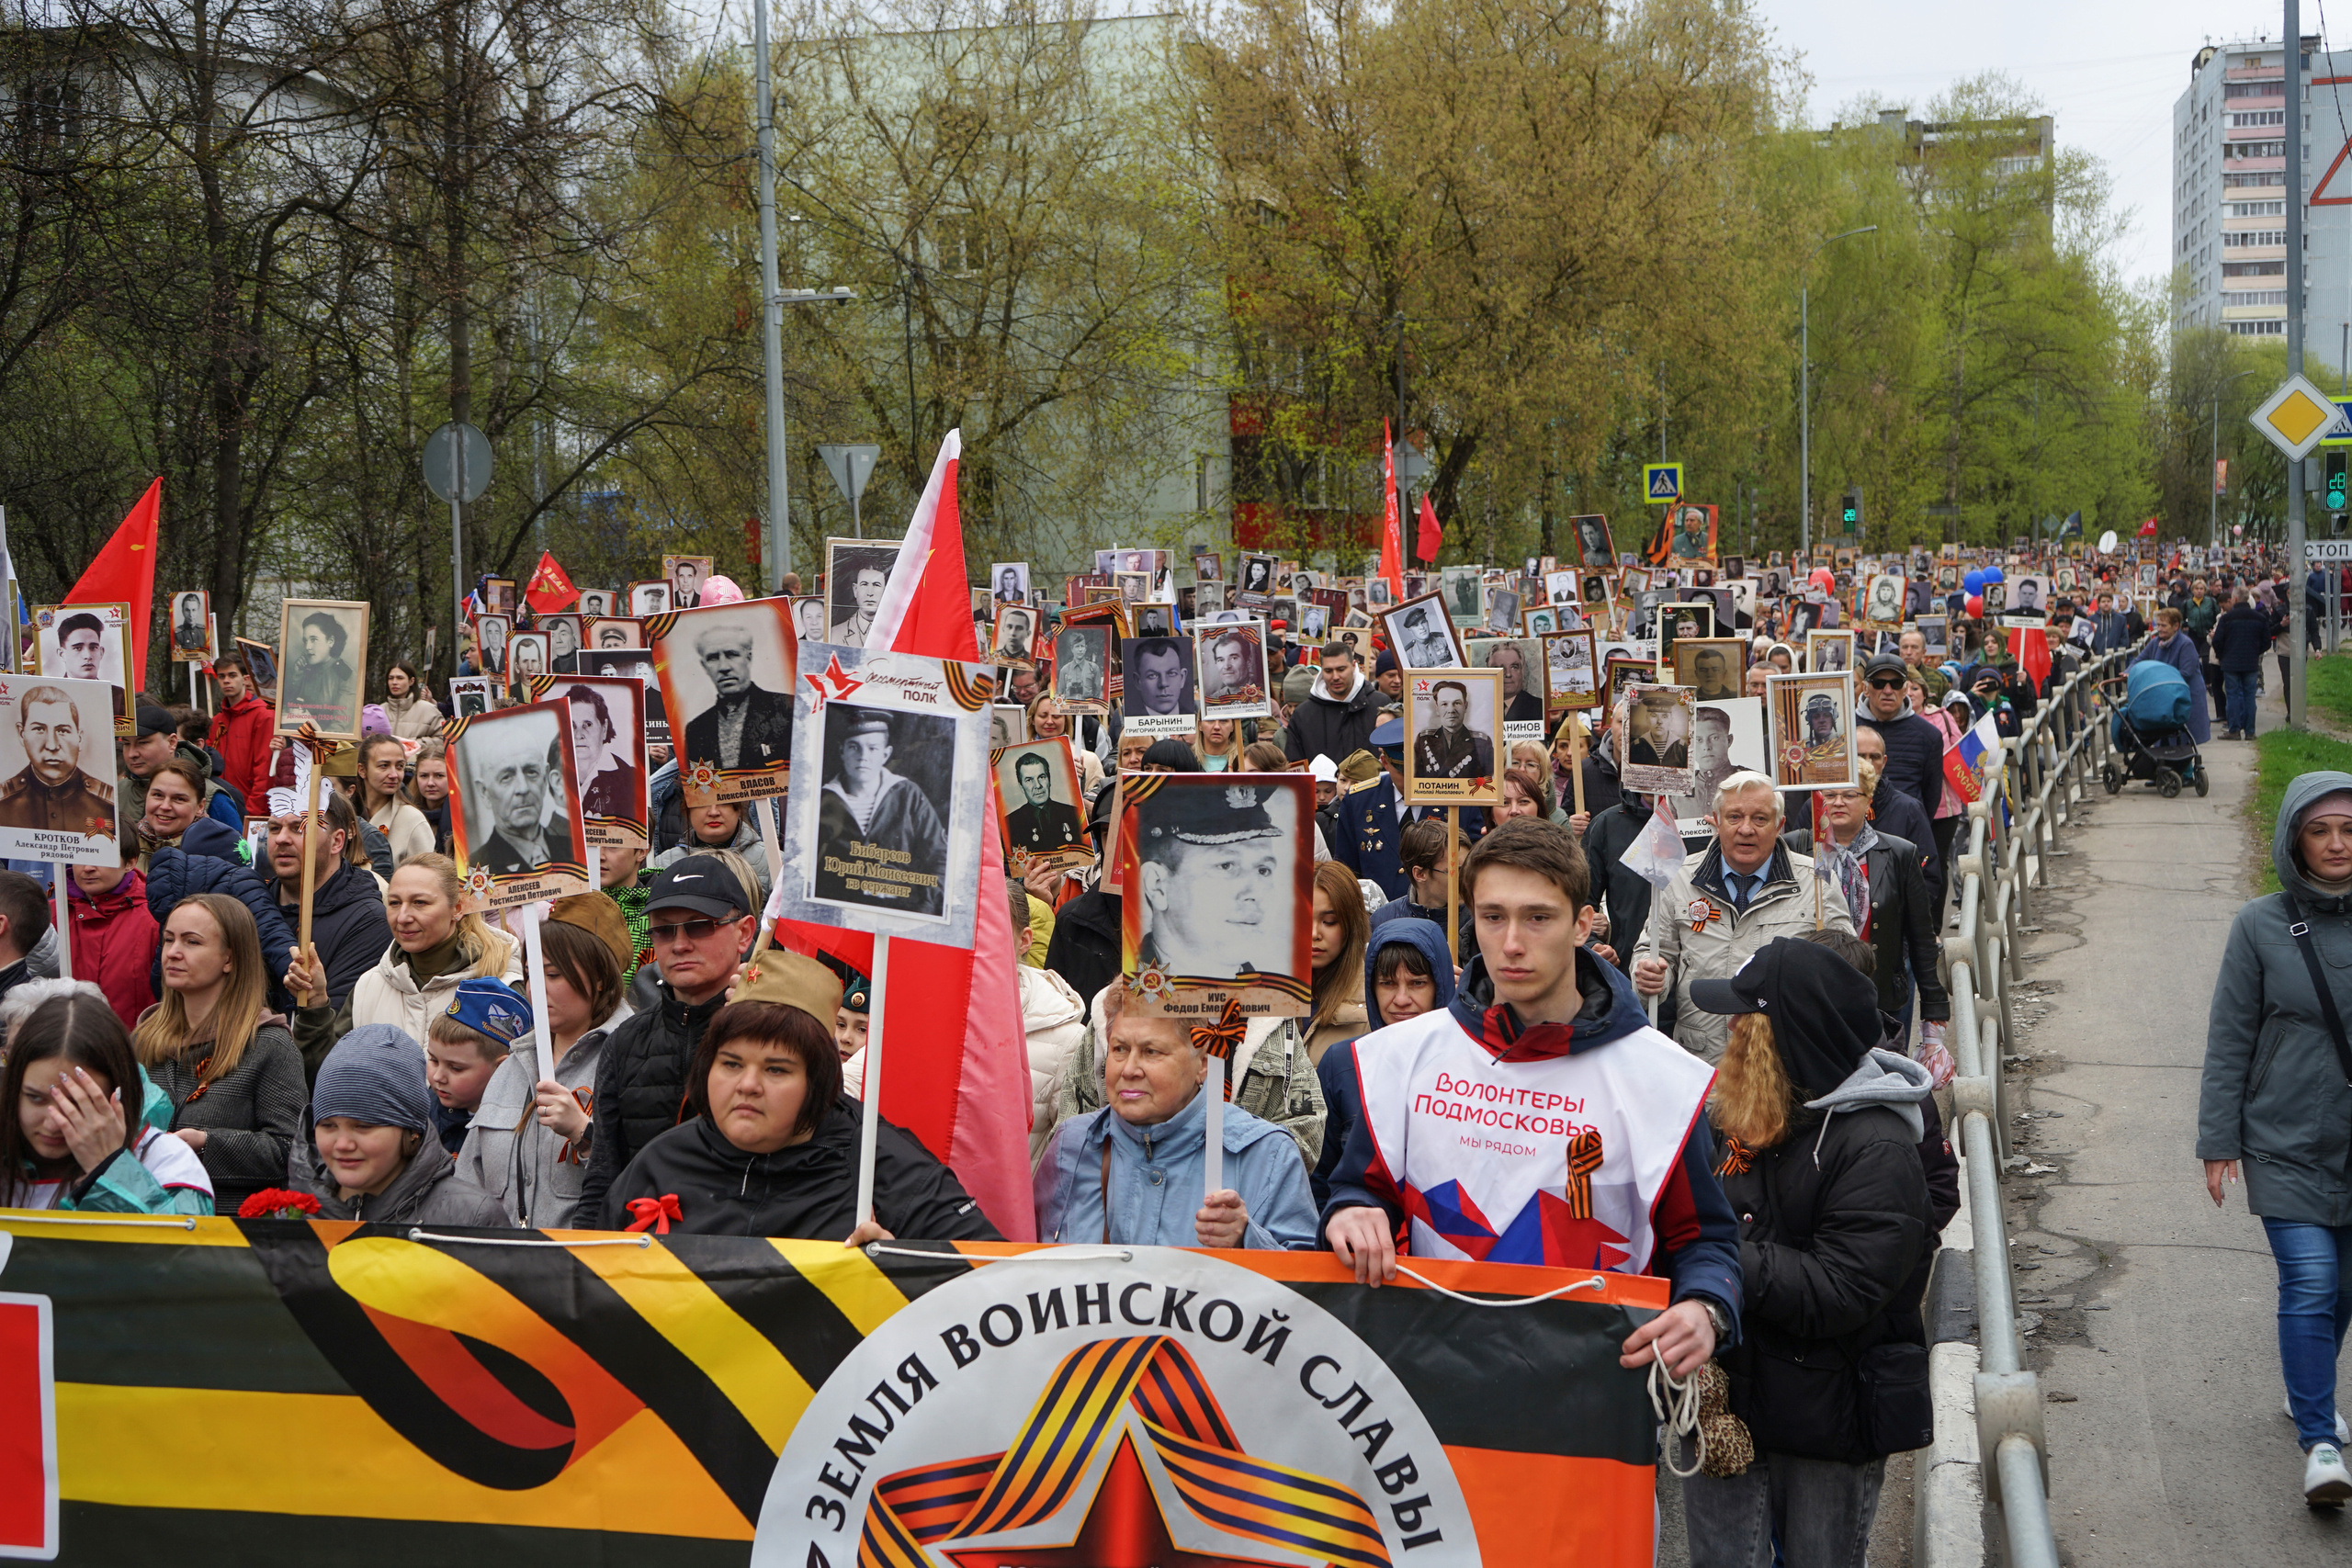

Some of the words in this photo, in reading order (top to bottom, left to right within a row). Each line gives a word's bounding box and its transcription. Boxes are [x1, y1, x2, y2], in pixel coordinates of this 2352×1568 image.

[1843, 508, 1856, 522] 28
[2304, 544, 2348, 558] СТОП
[903, 689, 938, 705] ПОЛК
[1137, 717, 1182, 727] БАРЫНИН
[740, 776, 775, 790] ВЛАСОВ
[1418, 782, 1460, 790] ПОТАНИН
[1952, 763, 1981, 802] РОССИ
[717, 789, 750, 802] Алексей
[750, 785, 789, 797] Афанасье
[33, 832, 81, 845] КРОТКОВ
[1679, 827, 1713, 837] Алексей
[15, 840, 59, 852] Александр
[61, 843, 100, 854] Петрович
[849, 840, 911, 864] Бибарсов
[40, 851, 74, 860] рядовой
[824, 856, 865, 877] Юрий
[865, 862, 938, 887] Моисеевич
[507, 880, 541, 895] АЛЕКСЕЕВ
[860, 880, 912, 898] сержант
[489, 892, 527, 907] Ростислав
[526, 886, 562, 900] Петрович
[1207, 992, 1227, 1002] ИУС
[1163, 1003, 1199, 1014] Федор
[1459, 1135, 1482, 1148] МЫ
[1484, 1141, 1537, 1157] РЯДОМ
[805, 1351, 941, 1533] ЗЕМЛЯ
[939, 1280, 1294, 1371] ВОИНСКОЙ
[1297, 1354, 1443, 1552] СЛАВЫ
